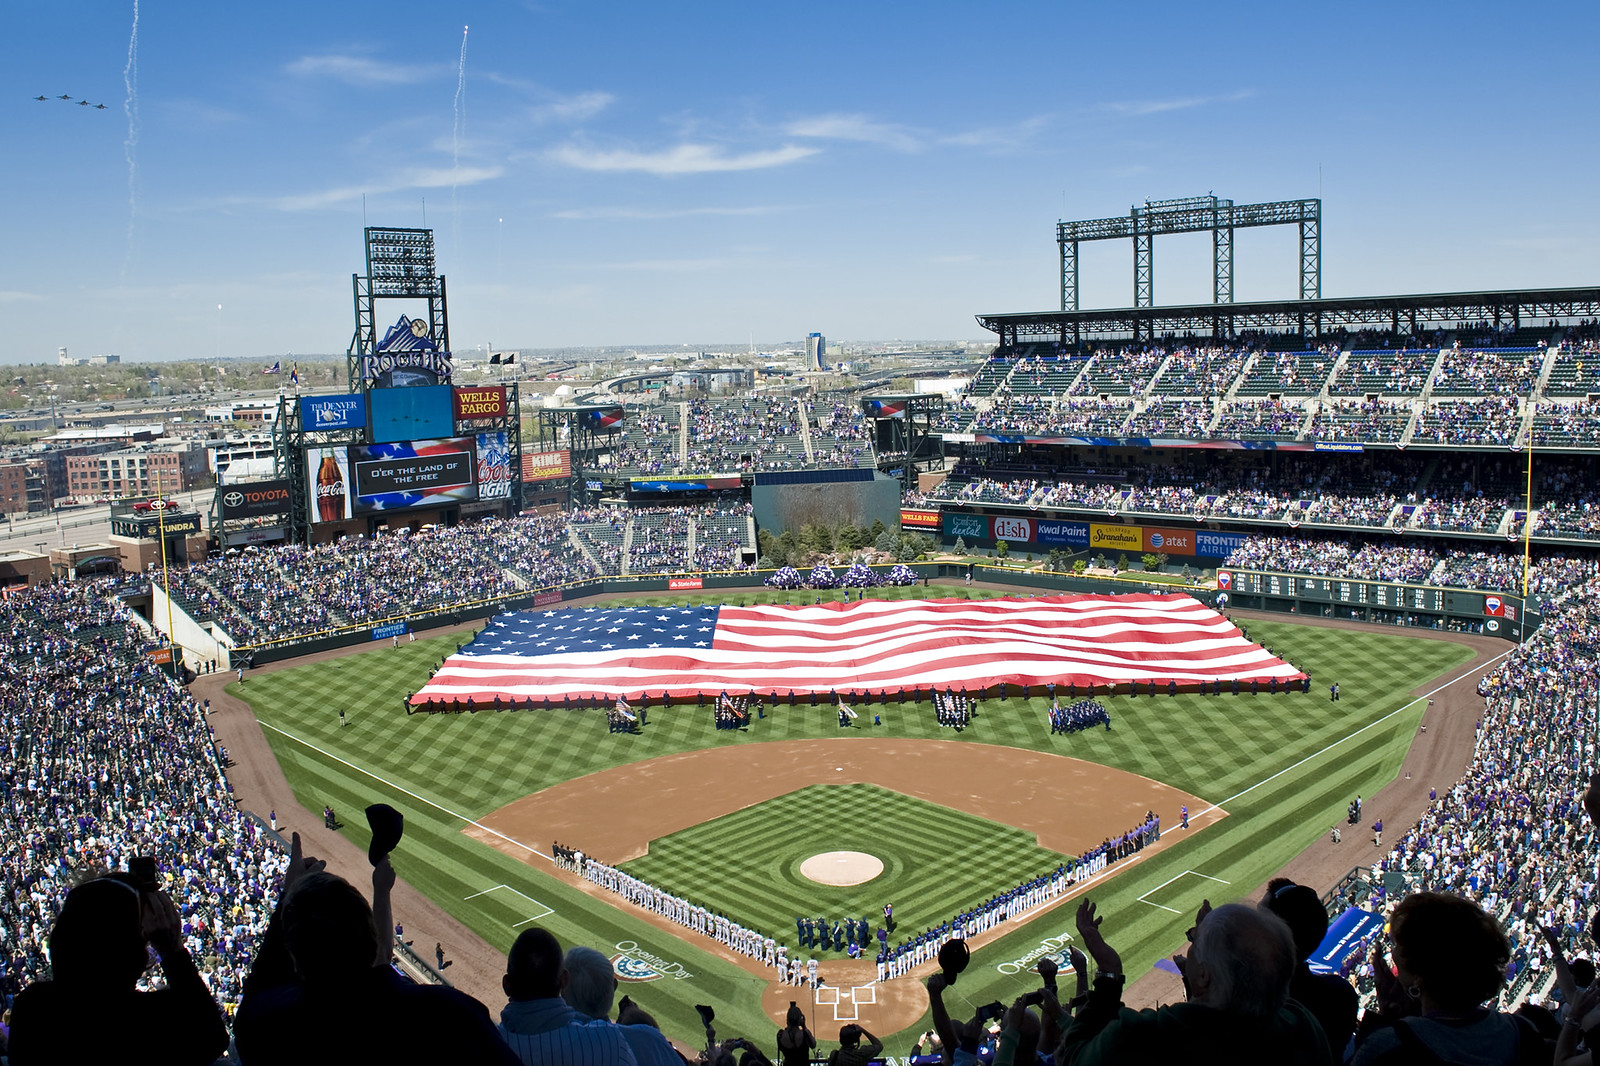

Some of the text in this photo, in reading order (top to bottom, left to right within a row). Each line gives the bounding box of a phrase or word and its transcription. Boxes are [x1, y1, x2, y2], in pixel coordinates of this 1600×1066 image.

[360, 351, 454, 379] ROCKIES
[459, 392, 500, 403] WELLS
[323, 401, 357, 410] DENVER
[461, 403, 500, 414] FARGO
[532, 453, 562, 467] KING
[371, 468, 394, 478] O'ER
[419, 464, 443, 473] LAND
[446, 462, 458, 470] OF
[393, 473, 439, 484] THE FREE
[244, 489, 289, 502] TOYOTA
[478, 482, 511, 498] LIGHT
[159, 522, 195, 533] TUNDRA
[952, 524, 981, 537] dental
[996, 520, 1028, 539] dish
[1038, 524, 1087, 537] Kwal Paint
[1093, 528, 1137, 543] Stranahan's
[1166, 536, 1187, 548] at&t
[1197, 534, 1245, 547] FRONTIE
[1201, 545, 1233, 555] AIRLIN
[373, 623, 405, 635] FRONTIER
[375, 630, 403, 639] AIRLINES
[156, 652, 170, 660] at&t
[997, 932, 1074, 974] Opening Day
[615, 940, 694, 980] Opening Day
